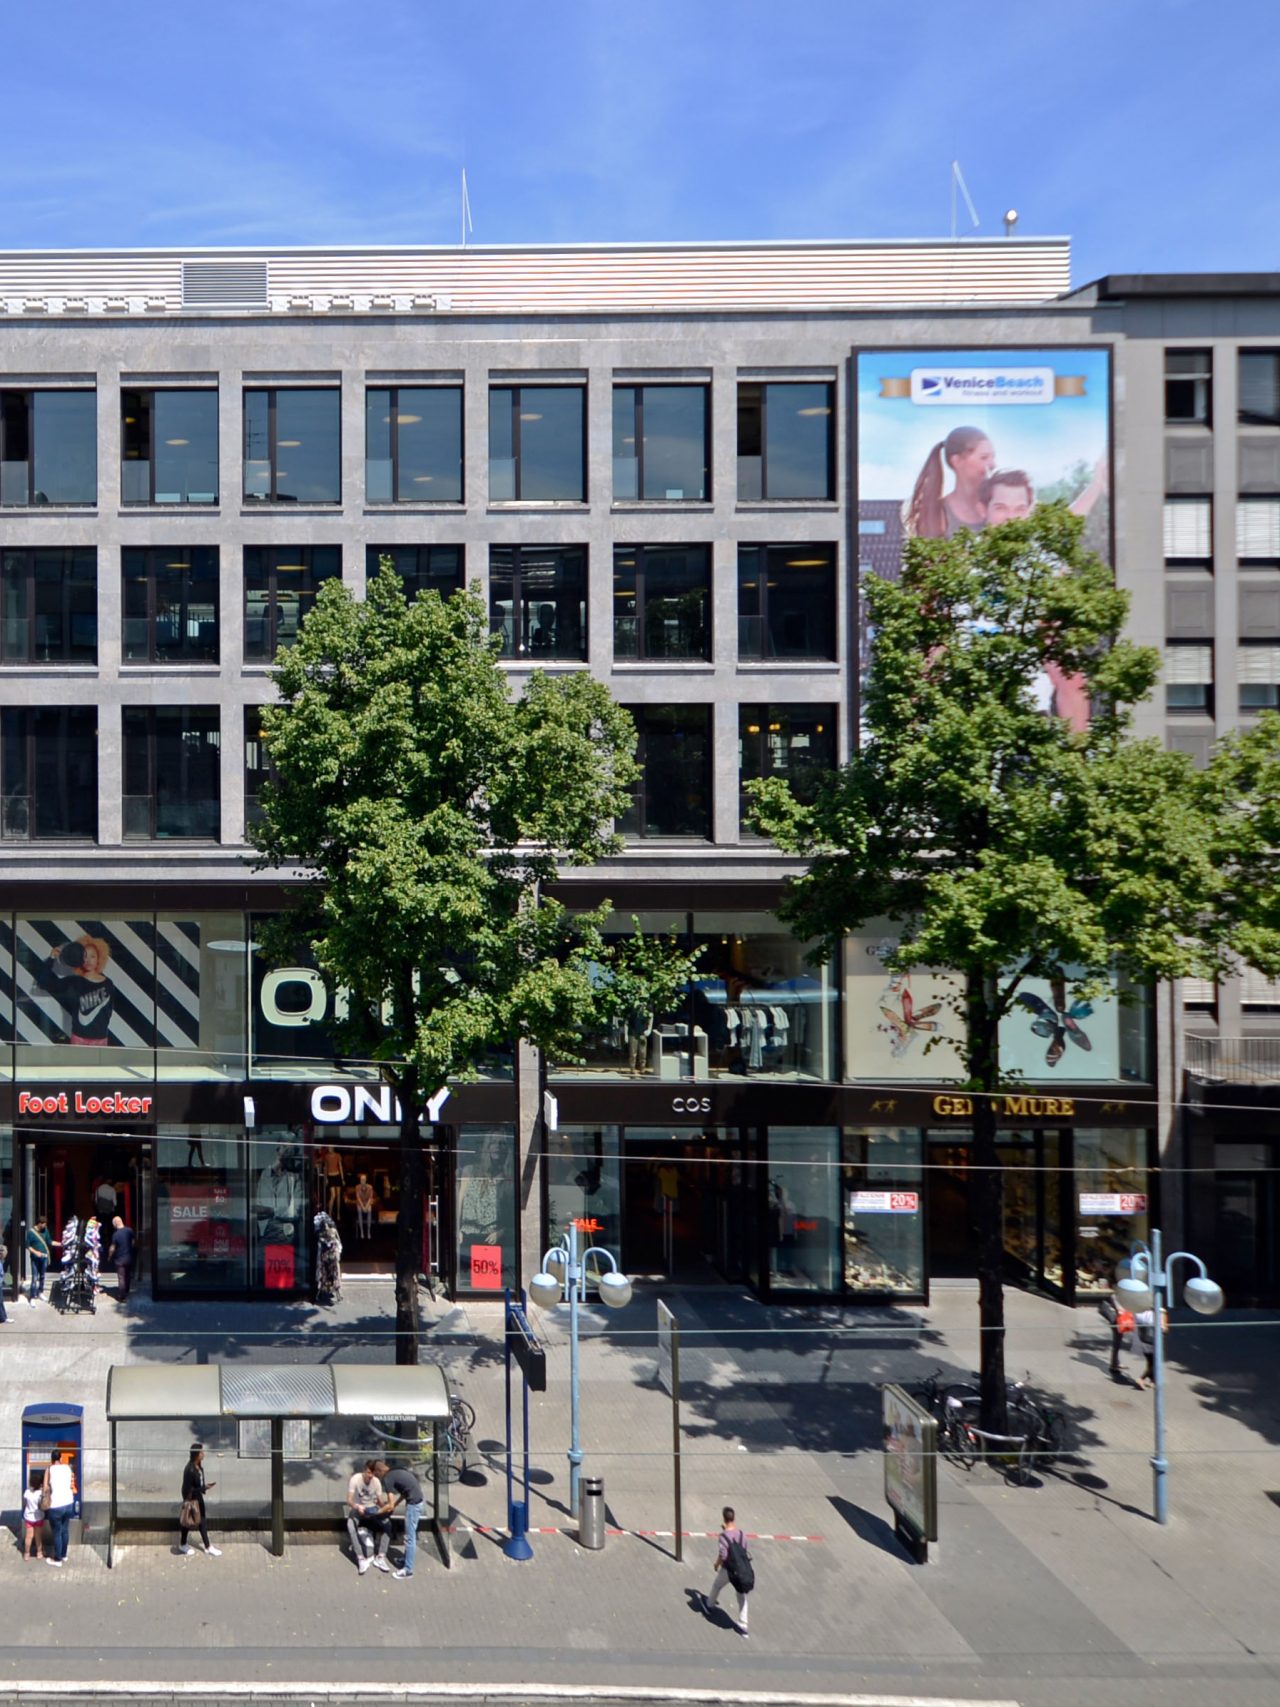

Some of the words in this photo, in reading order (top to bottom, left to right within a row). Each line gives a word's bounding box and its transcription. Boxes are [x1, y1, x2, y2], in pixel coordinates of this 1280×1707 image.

[943, 376, 1044, 388] VeniceBeach
[80, 987, 110, 1012] NIKE
[19, 1091, 68, 1114] Foot
[75, 1091, 152, 1114] Locker
[672, 1097, 711, 1112] COS
[173, 1206, 208, 1218] SALE
[473, 1259, 499, 1275] 50%
